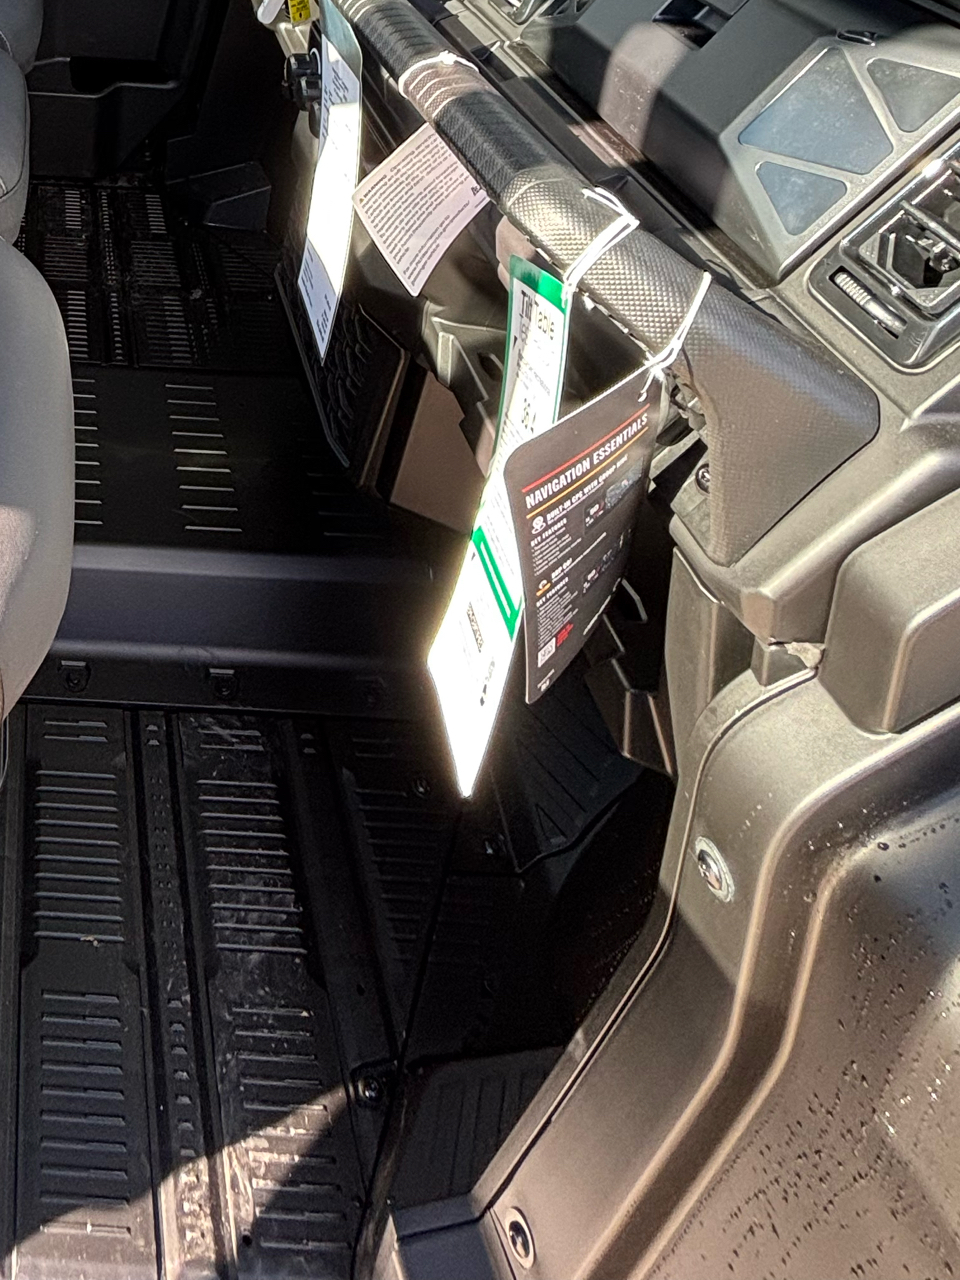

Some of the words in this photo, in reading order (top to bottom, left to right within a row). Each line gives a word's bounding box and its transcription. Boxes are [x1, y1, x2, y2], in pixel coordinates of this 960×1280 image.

[525, 456, 590, 509] NAVIGATION
[593, 412, 649, 465] ESSENTIALS
[546, 500, 571, 520] BUILT-IN
[571, 489, 583, 505] GPS
[584, 479, 599, 495] WITH
[542, 518, 568, 540] FEATURES
